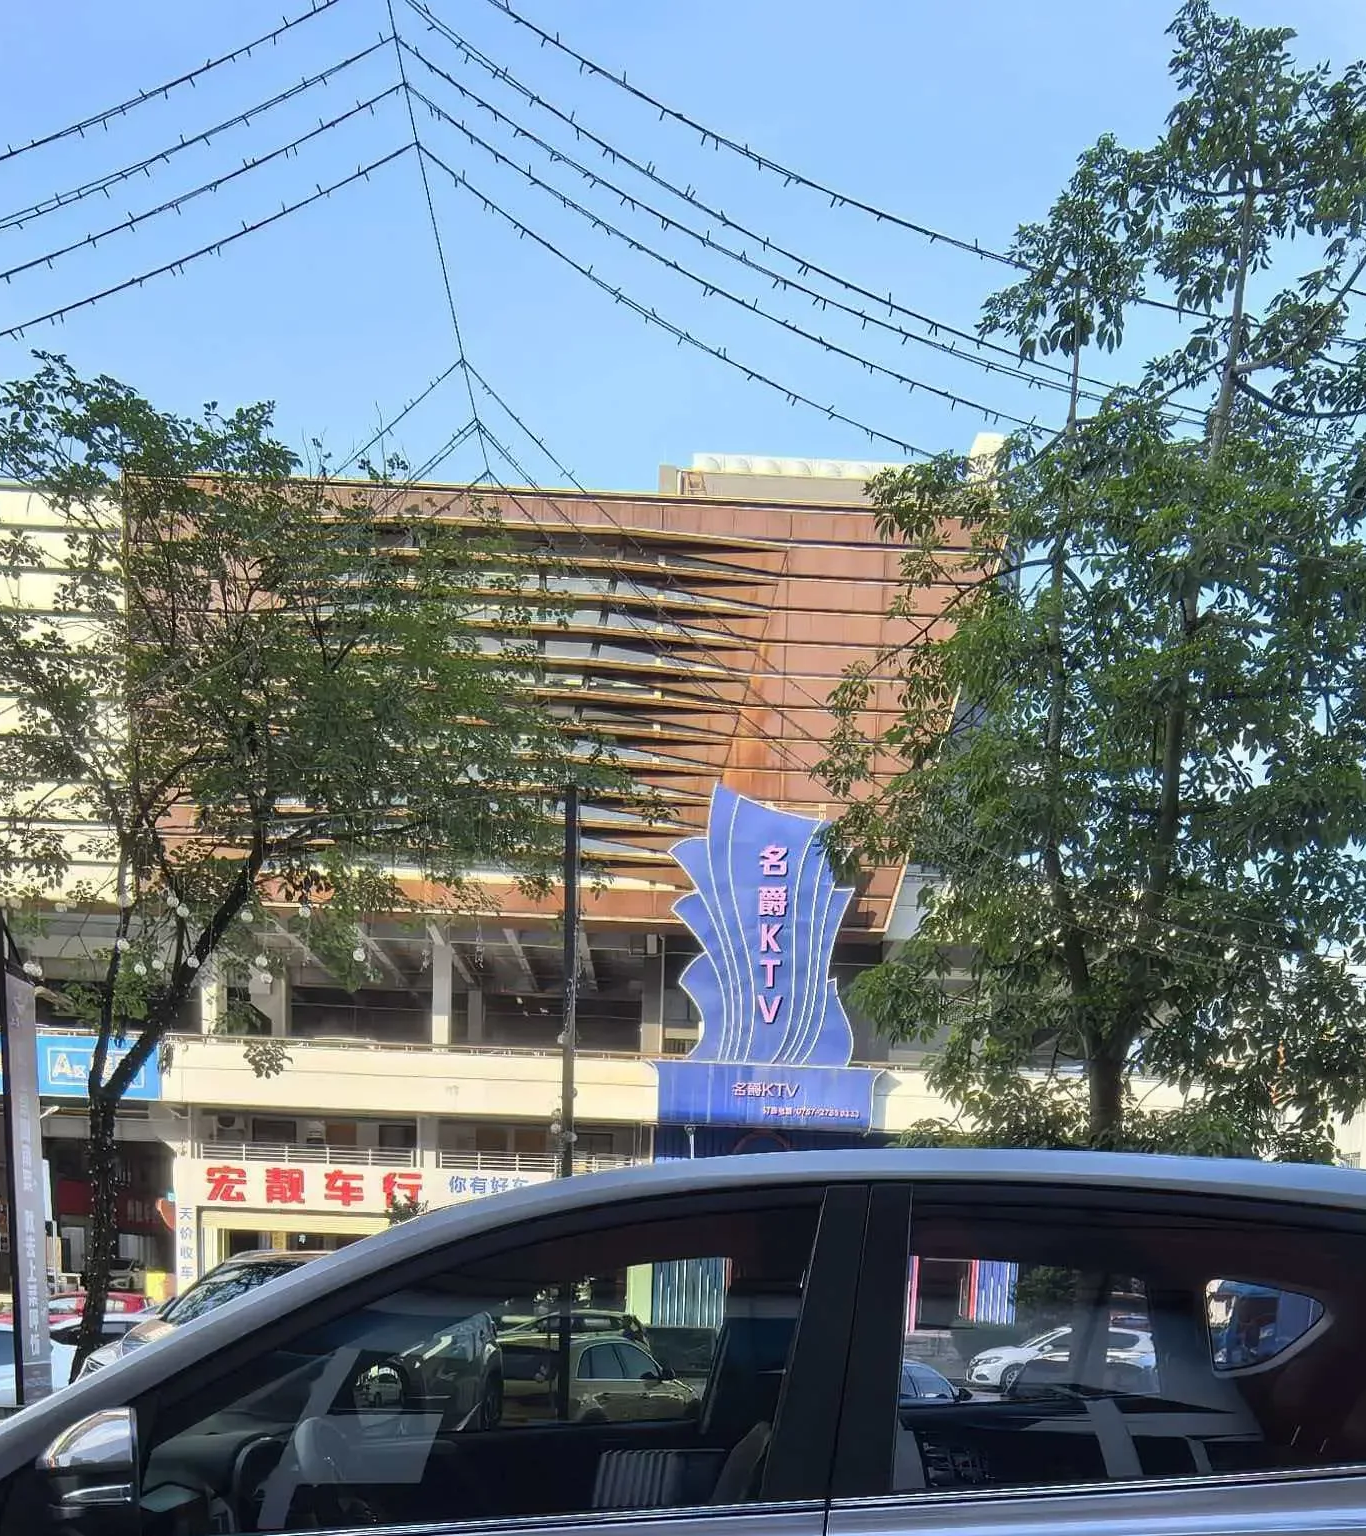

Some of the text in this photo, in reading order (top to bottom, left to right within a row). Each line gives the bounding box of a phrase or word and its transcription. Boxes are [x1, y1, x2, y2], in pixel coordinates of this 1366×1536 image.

[758, 843, 788, 1025] 名爵KTV
[732, 1081, 800, 1098] 名爵KTV
[206, 1165, 424, 1208] 宏靓车行
